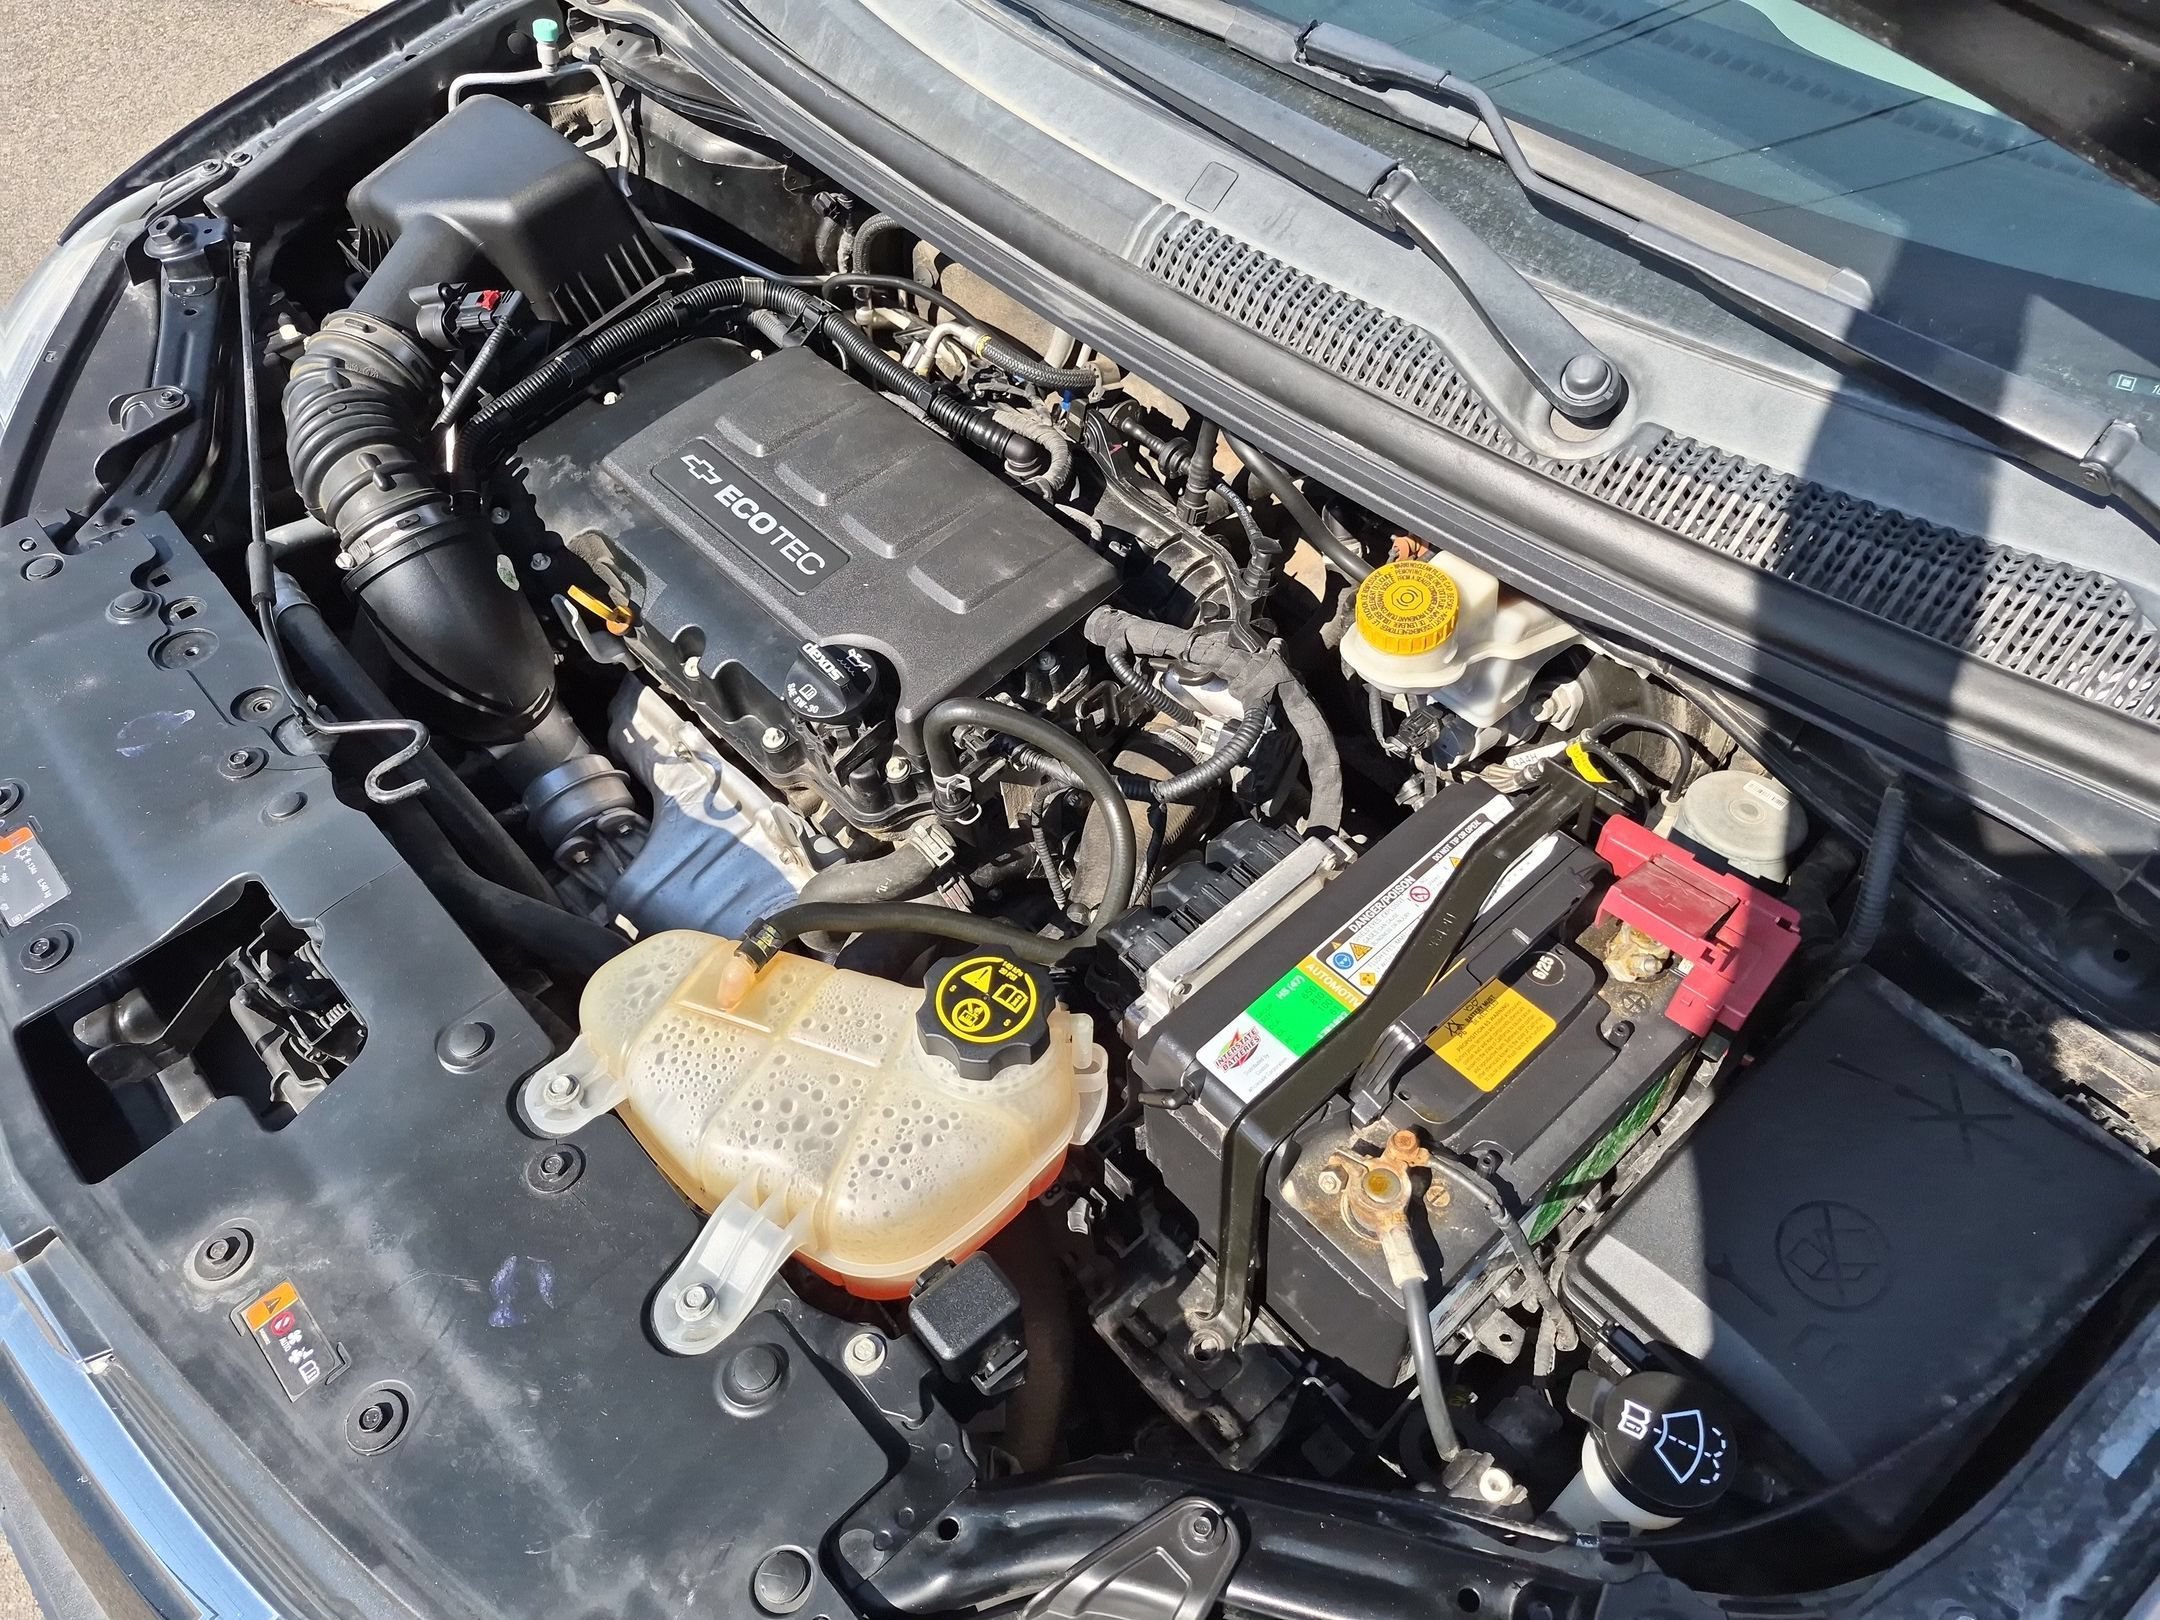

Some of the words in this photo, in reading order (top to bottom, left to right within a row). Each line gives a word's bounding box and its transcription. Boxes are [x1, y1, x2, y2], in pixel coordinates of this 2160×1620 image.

[713, 484, 826, 575] ECOTEC
[1443, 580, 1454, 591] CAP
[802, 642, 845, 681] dexos
[787, 682, 798, 698] SAE
[793, 696, 819, 714] 5W-30
[1432, 853, 1441, 861] DO
[1439, 844, 1451, 854] NOT
[1450, 837, 1460, 846] TIP
[1458, 831, 1466, 839] OR
[1348, 876, 1414, 932] DANGER/POISON
[1532, 956, 1554, 979] 6/25
[1301, 986, 1316, 999] 650
[1307, 964, 1360, 1006] AUTOMOTIV
[1310, 992, 1324, 1004] 810
[1318, 999, 1332, 1011] 100
[1329, 1006, 1339, 1015] 61
[1465, 1005, 1482, 1022] BATTERY
[1482, 995, 1494, 1006] MUST
[1215, 1028, 1256, 1066] INTERSTATE
[1457, 1025, 1483, 1051] PROPOSITION
[1222, 1035, 1260, 1070] BATTERIES
[279, 1337, 291, 1352] AUTO
